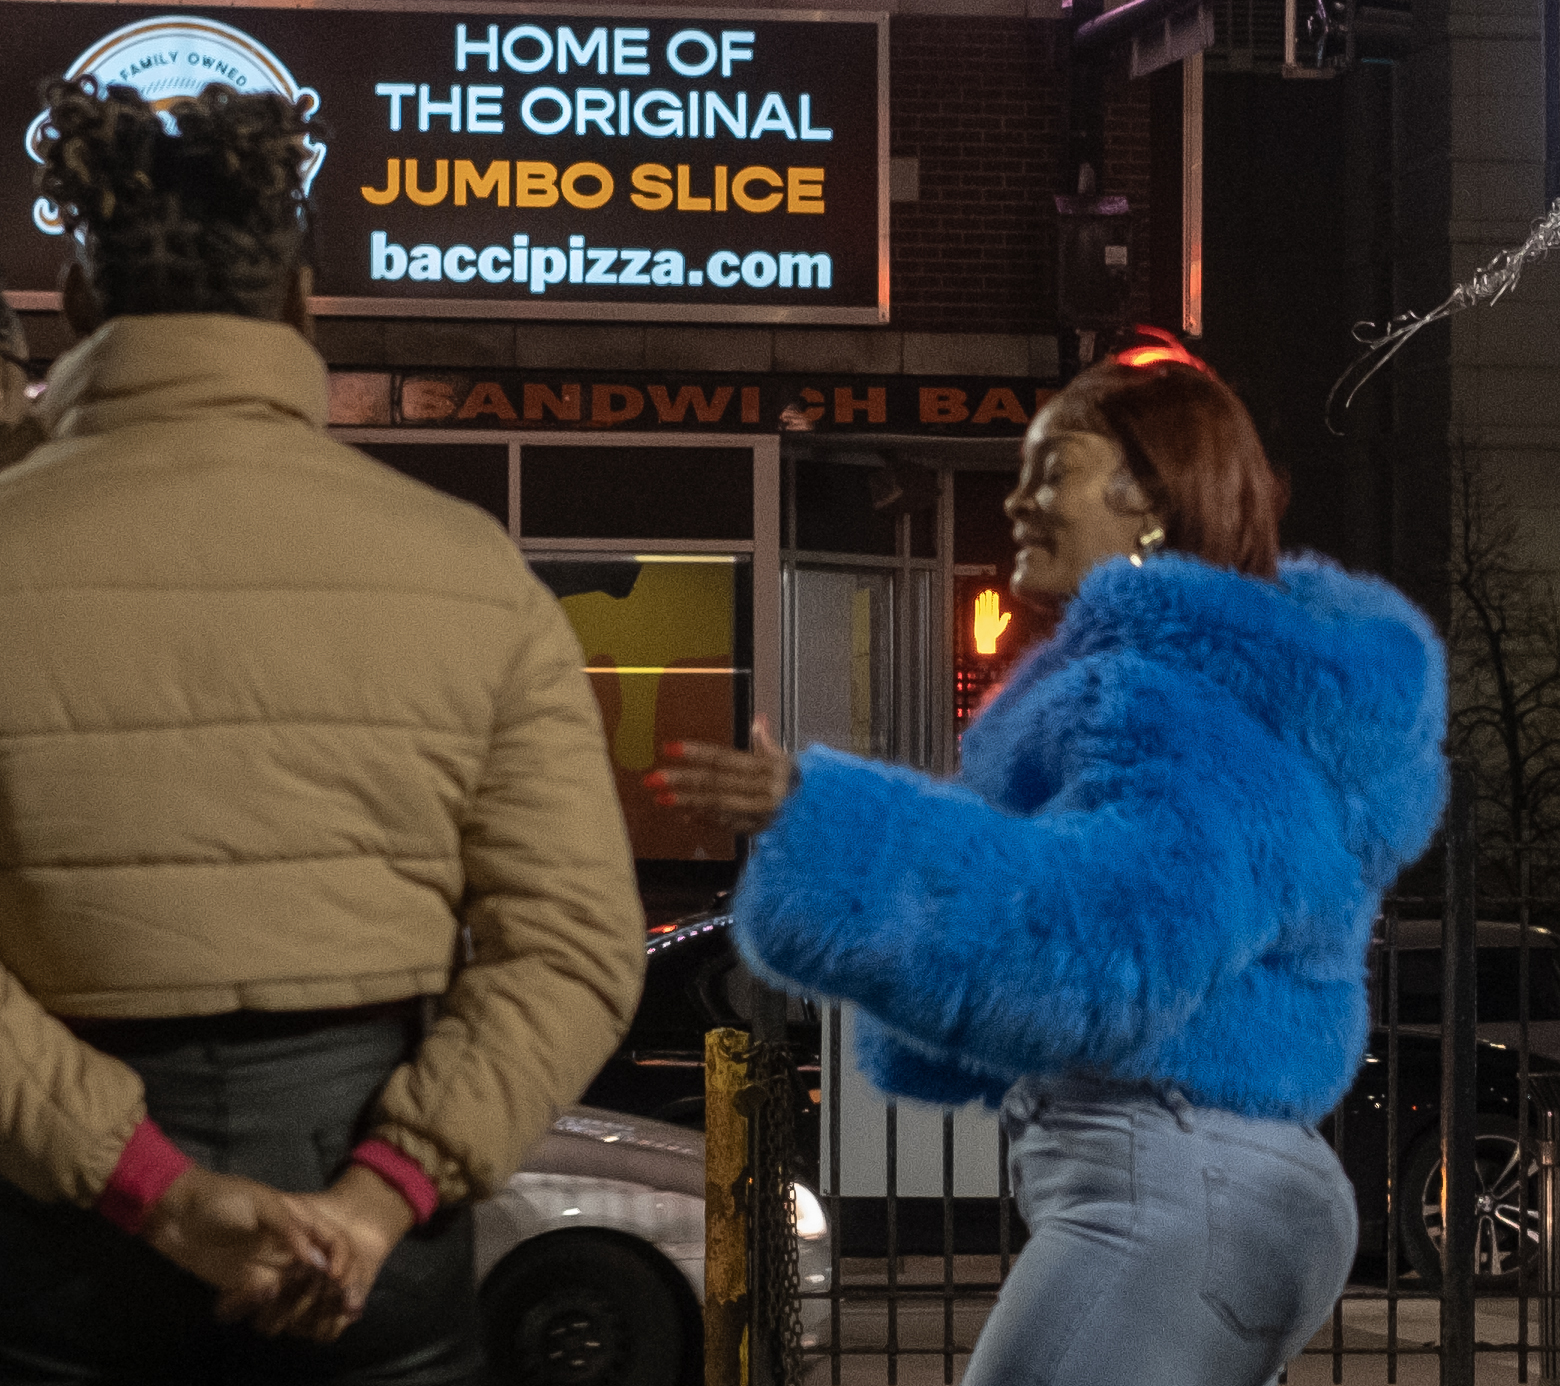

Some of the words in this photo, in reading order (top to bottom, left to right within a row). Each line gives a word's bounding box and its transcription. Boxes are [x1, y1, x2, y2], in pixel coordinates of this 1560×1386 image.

[119, 51, 179, 81] FAMILY
[187, 51, 247, 88] OWNED
[455, 23, 652, 76] HOME
[665, 28, 757, 79] OF
[375, 82, 506, 135] THE
[519, 85, 834, 142] ORIGINAL
[359, 157, 616, 211] JUMBO
[629, 161, 827, 215] SLICE
[370, 229, 833, 295] baccipizza.com
[918, 387, 1060, 425] BA
